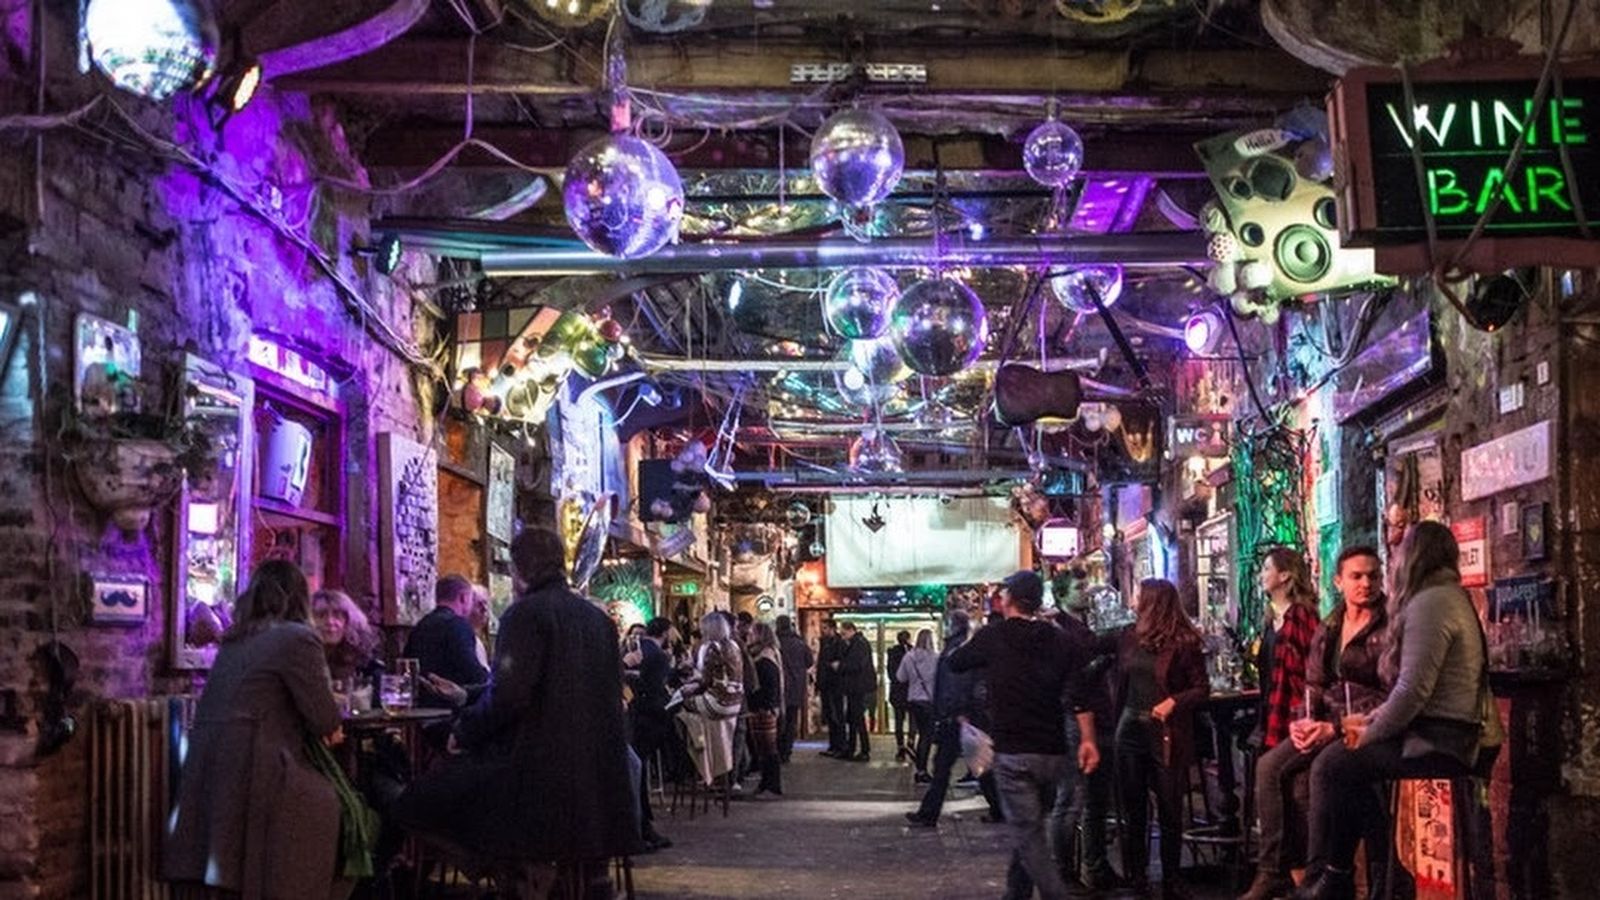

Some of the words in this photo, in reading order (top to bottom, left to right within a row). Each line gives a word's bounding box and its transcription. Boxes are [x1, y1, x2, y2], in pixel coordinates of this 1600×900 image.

[1386, 99, 1587, 149] WINE
[1427, 165, 1573, 215] BAR
[1176, 428, 1207, 443] WC
